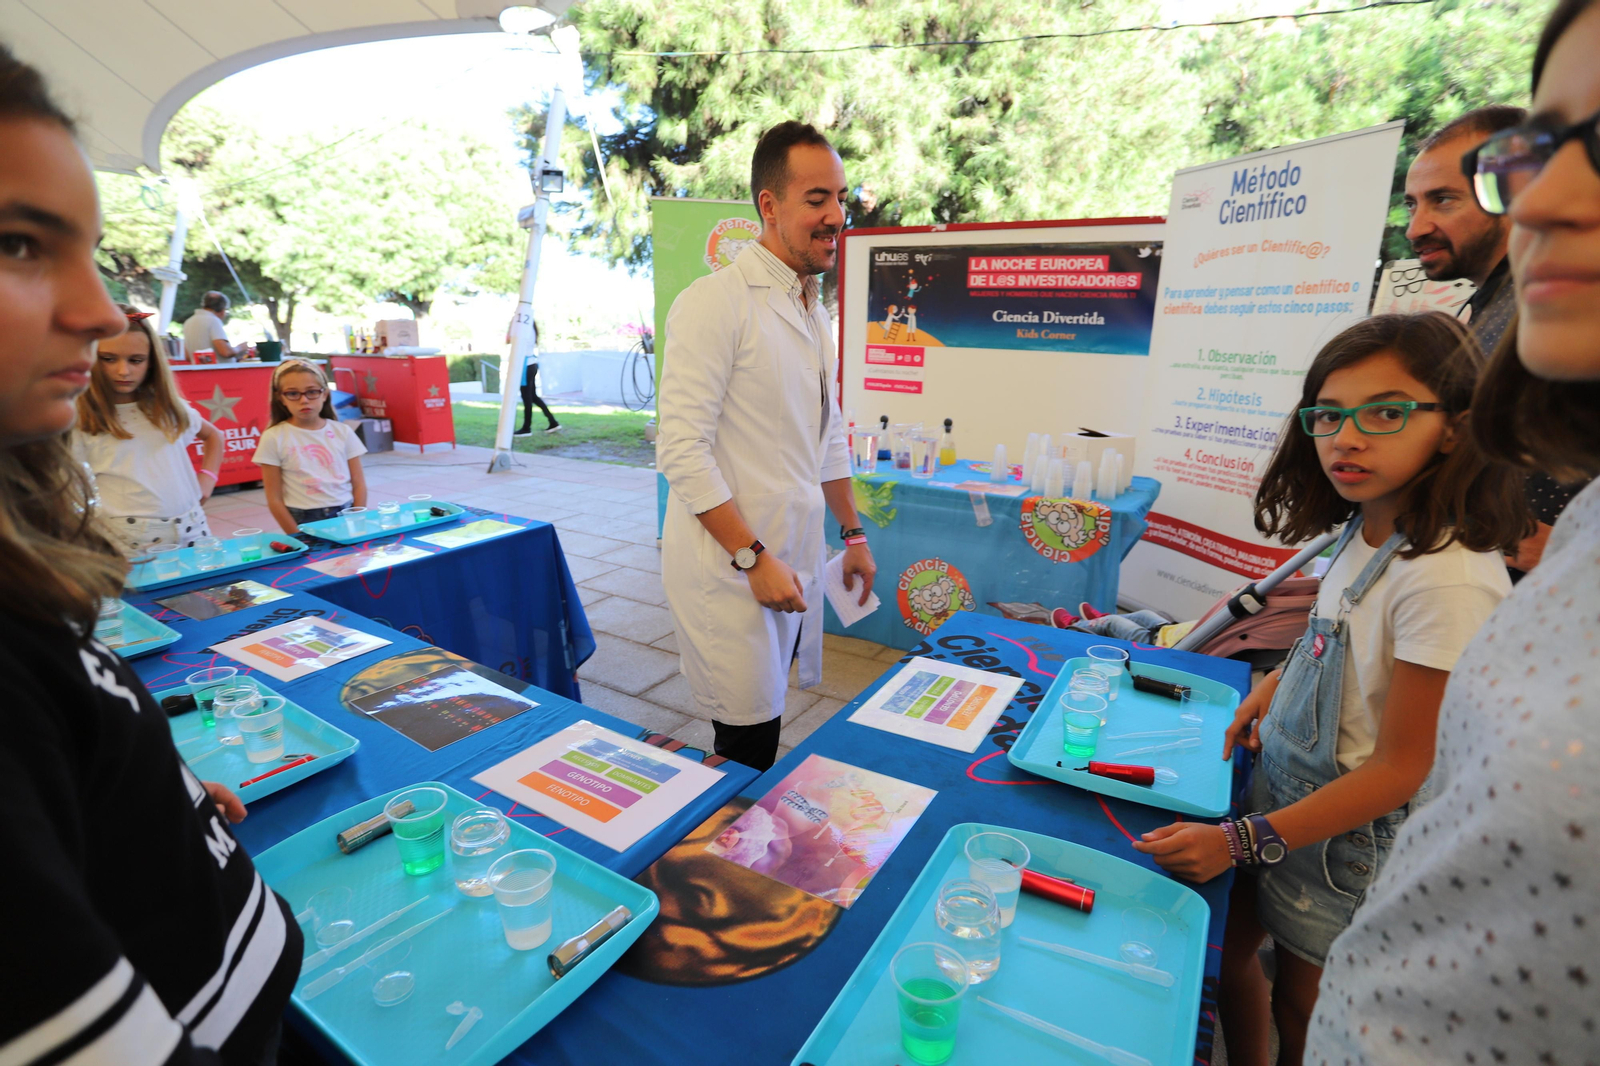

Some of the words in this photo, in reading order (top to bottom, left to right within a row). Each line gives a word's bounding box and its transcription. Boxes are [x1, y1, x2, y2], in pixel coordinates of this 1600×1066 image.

[1231, 161, 1302, 197] Método
[1219, 191, 1307, 225] Científico
[714, 219, 762, 237] ciencia
[1231, 244, 1246, 255] ser
[1247, 243, 1258, 253] un
[970, 259, 988, 270] LA
[991, 258, 1036, 270] NOCHE
[1040, 258, 1104, 270] EUROPEA
[970, 274, 986, 286] DE
[989, 275, 1016, 286] L@S
[1018, 274, 1138, 288] INVESTIGADOR@S
[1164, 287, 1182, 299] Para
[1183, 285, 1218, 301] aprender
[1225, 286, 1255, 300] pensar
[1256, 286, 1281, 296] como
[1282, 285, 1294, 296] un
[1352, 281, 1360, 292] o
[992, 310, 1040, 323] Ciencia
[1042, 311, 1105, 325] Divertida
[1203, 301, 1228, 314] debes
[1229, 301, 1257, 317] seguir
[1257, 300, 1283, 314] estos
[1284, 300, 1314, 314] cinco
[1016, 329, 1039, 339] Kids
[1040, 330, 1077, 340] Corner
[1198, 348, 1205, 362] 1.
[1208, 349, 1277, 366] Observación
[1196, 387, 1206, 400] 2.
[1209, 388, 1263, 406] Hipótesis
[1174, 416, 1183, 429] 3.
[1186, 417, 1278, 443] Experimentación
[227, 438, 257, 452] SUR
[1184, 448, 1193, 462] 4.
[1196, 450, 1255, 473] Conclusión
[1018, 512, 1070, 565] ciencia
[898, 556, 949, 591] ciencia
[567, 771, 612, 793] GENOTIPO
[612, 770, 653, 790] DOMINANTES
[546, 784, 590, 806] FENOTIPO
